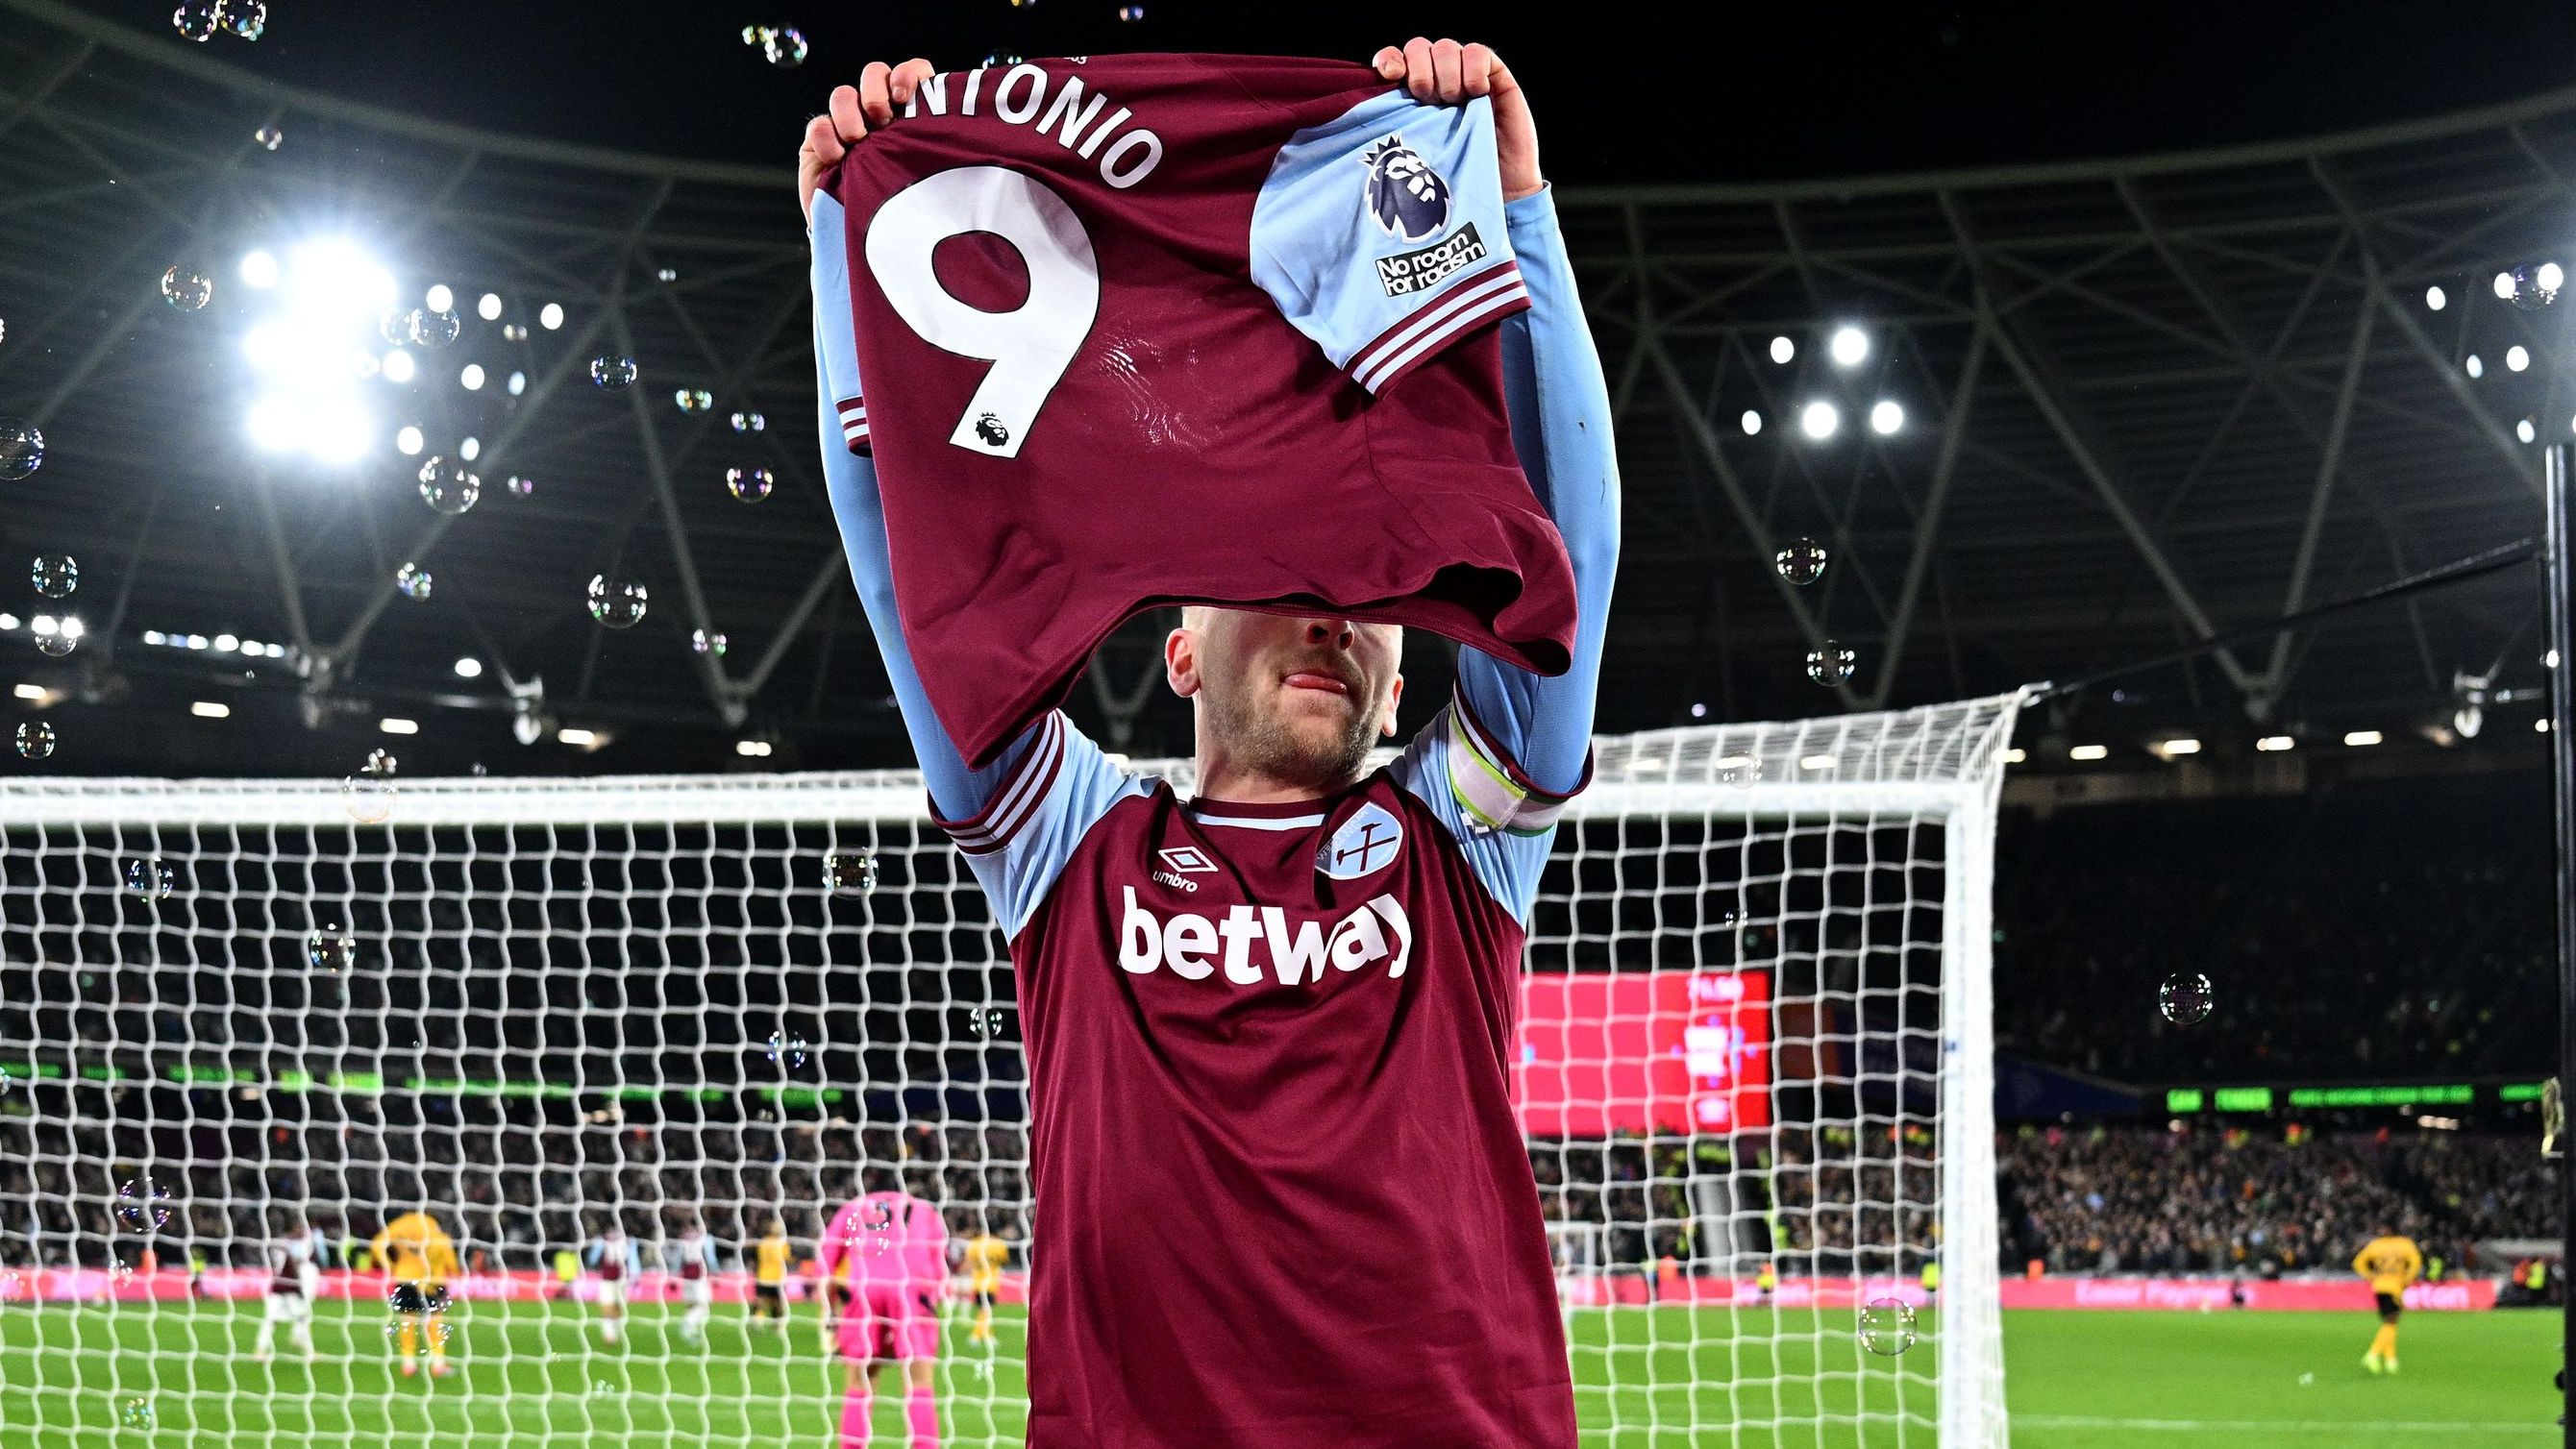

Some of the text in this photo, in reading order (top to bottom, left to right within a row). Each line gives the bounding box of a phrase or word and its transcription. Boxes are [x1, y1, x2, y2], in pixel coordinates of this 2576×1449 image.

[904, 63, 1163, 189] NTONIO
[1375, 233, 1470, 280] No room
[1383, 242, 1486, 296] for racism
[864, 164, 1101, 459] 9
[1152, 871, 1198, 893] umbro
[1117, 885, 1412, 986] betway
